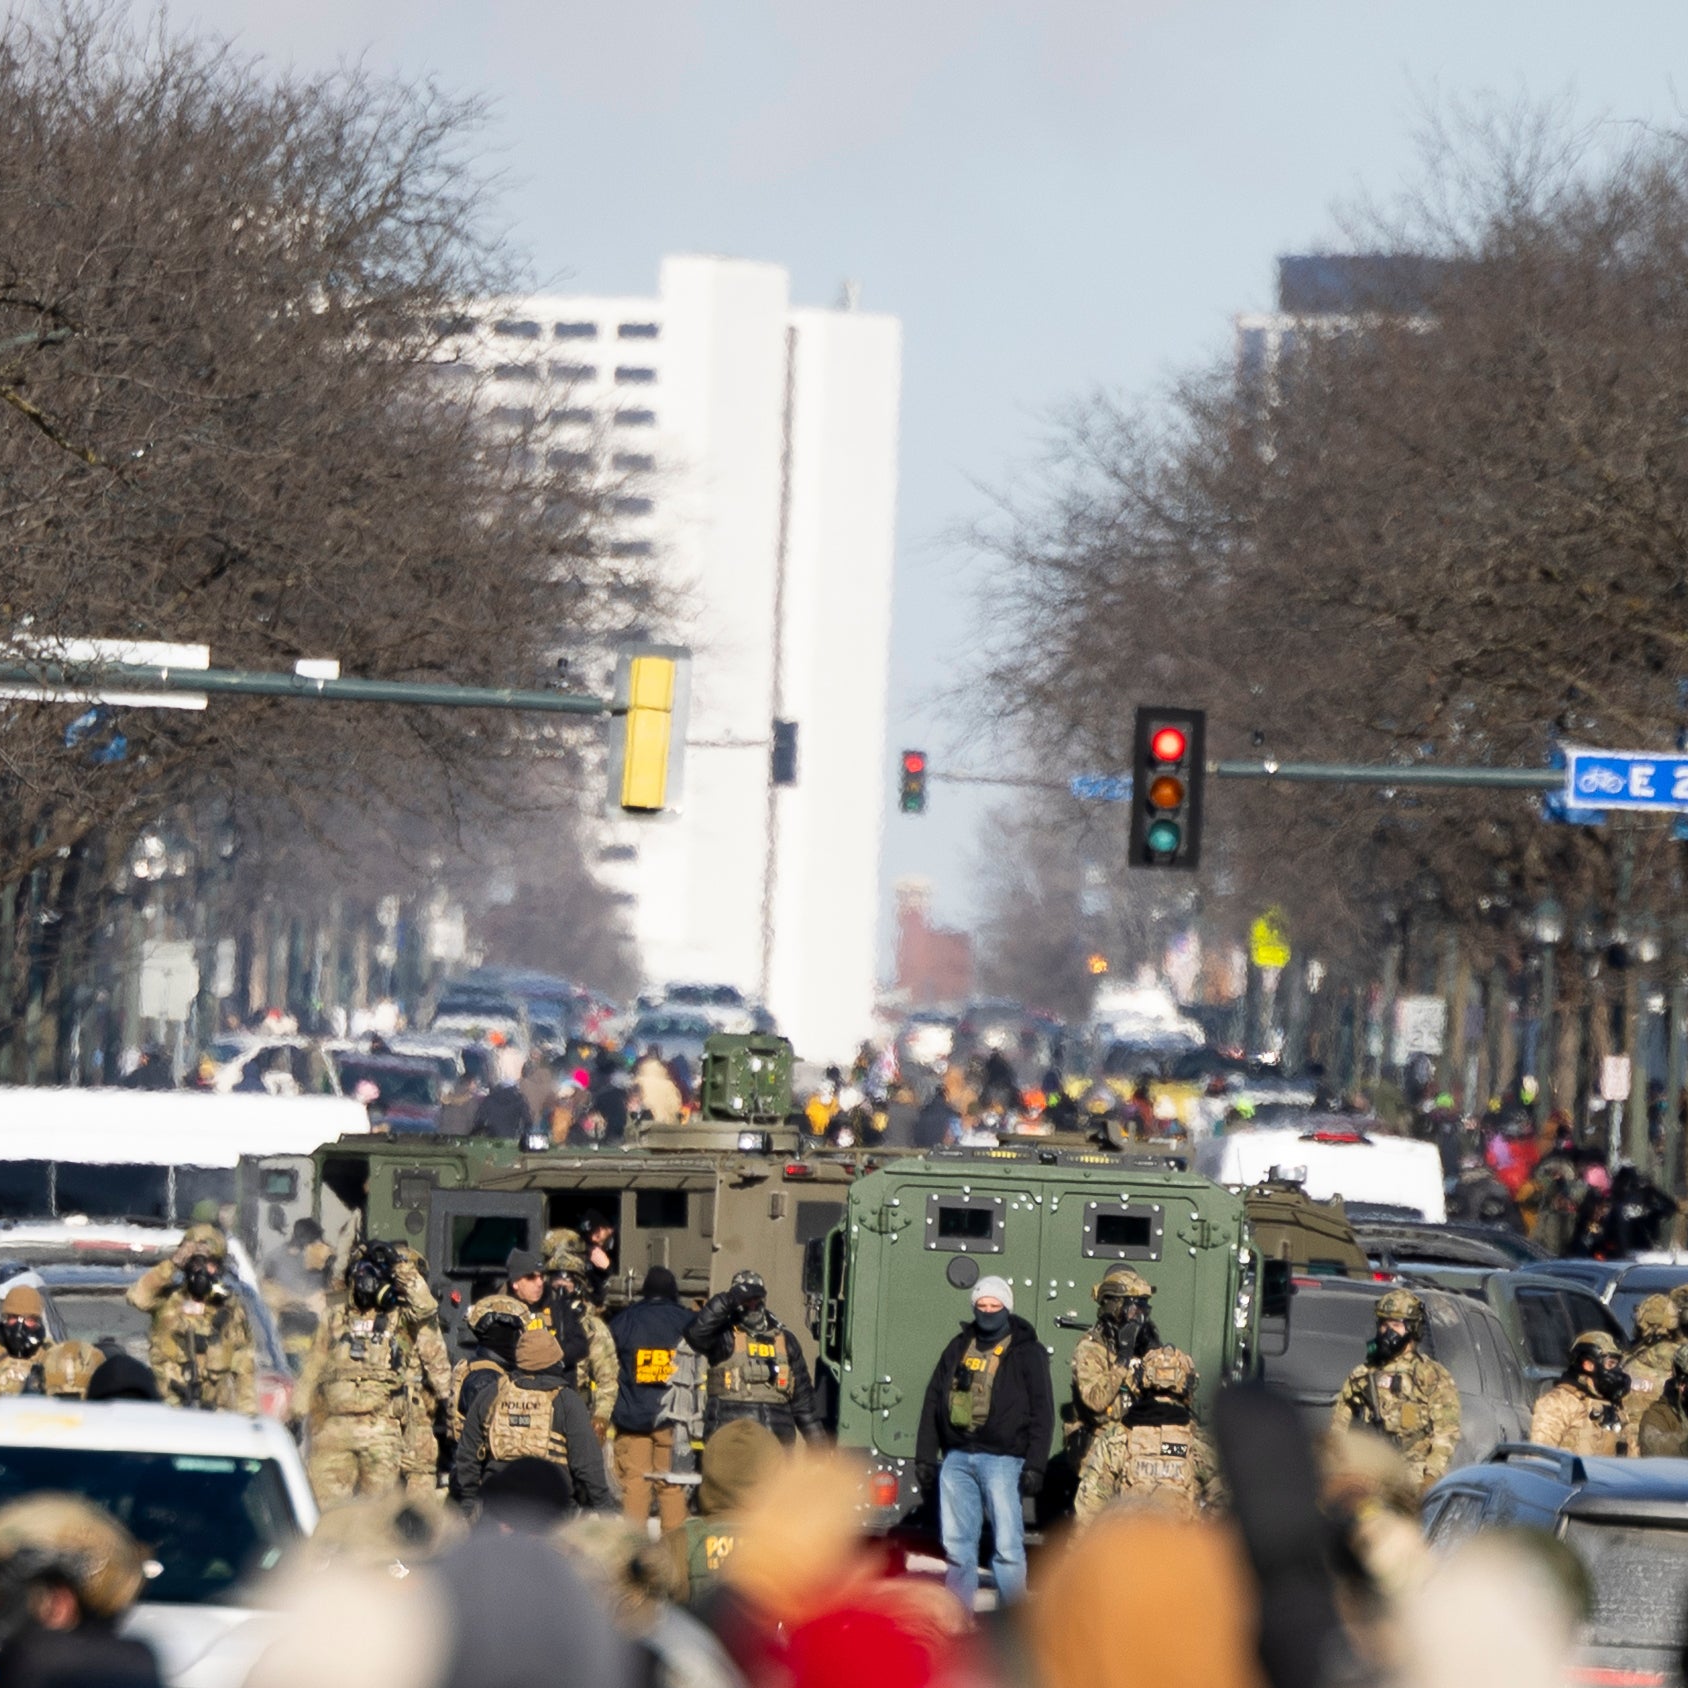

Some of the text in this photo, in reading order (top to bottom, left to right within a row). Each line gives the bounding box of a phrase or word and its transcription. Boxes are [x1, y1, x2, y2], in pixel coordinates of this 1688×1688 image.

[1629, 763, 1656, 798] E
[748, 1343, 775, 1357] FBI
[965, 1357, 987, 1371] FBI
[500, 1401, 541, 1411] POLICE
